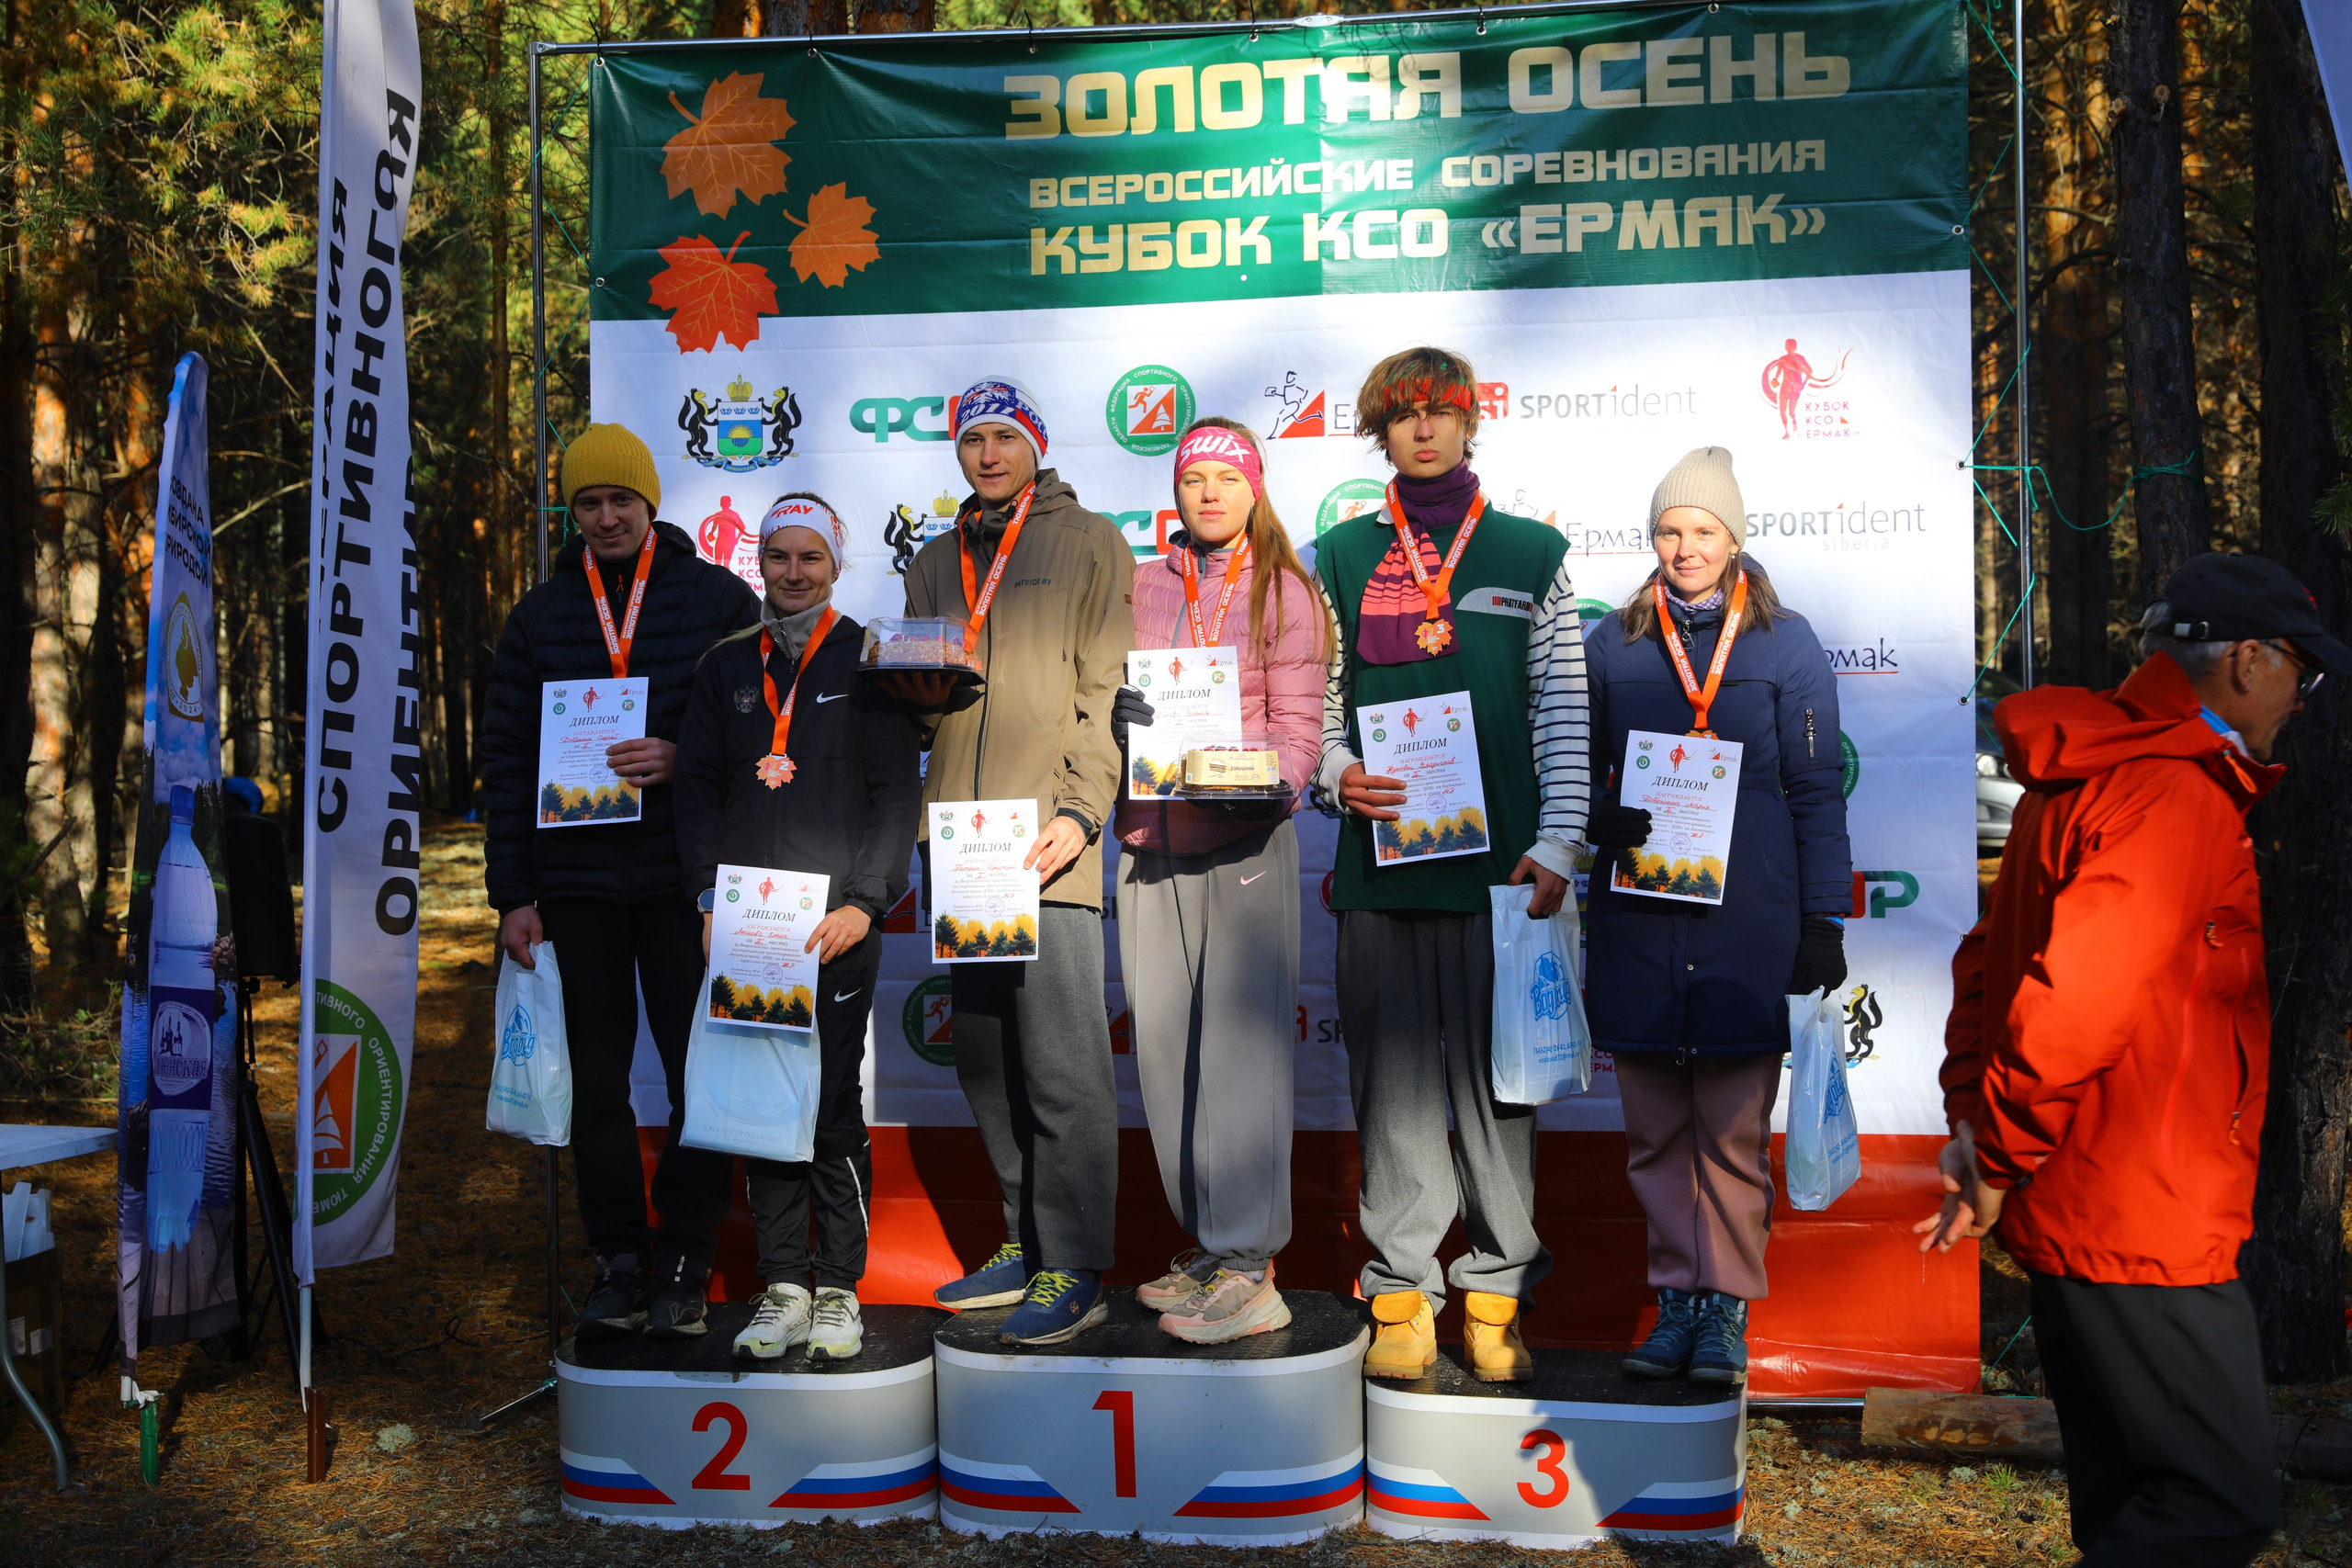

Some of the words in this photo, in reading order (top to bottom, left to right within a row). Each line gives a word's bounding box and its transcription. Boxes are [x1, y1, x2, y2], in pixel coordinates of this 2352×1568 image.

[1004, 51, 1462, 140] ЗОЛОТАЯ
[1508, 31, 1850, 113] ОСЕНЬ
[1030, 157, 1413, 209] ВСЕРОССИЙСКИЕ
[1441, 140, 1826, 187] СОРЕВНОВАНИЯ
[1030, 215, 1272, 275] КУБОК
[1302, 209, 1448, 261] КСО
[1481, 194, 1826, 254] «ЕРМАК»
[1133, 368, 1178, 382] СПОРТИВНОГО
[1110, 378, 1131, 413] ФЕДЕРАЦИЯ
[1805, 400, 1850, 412] КУБОК
[1110, 416, 1128, 443] ОБЛАСТИ
[1805, 416, 1834, 425] КСО
[1131, 442, 1171, 453] ТЮМЕНСКОЙ
[317, 147, 397, 833] СПОРТИВНОГО
[1012, 494, 1030, 525] ТЮМЕНЬ
[1320, 491, 1342, 527] ФЕДЕРАЦИЯ
[1403, 525, 1416, 548] ОСЕНЬ
[1448, 536, 1466, 570] ЗОЛОТАЯ
[1463, 517, 1477, 538] ОСЕНЬ
[1823, 537, 1890, 551] siberia
[1410, 548, 1429, 581] ЗОЛОТАЯ
[978, 581, 997, 616] ЗОЛОТАЯ
[993, 554, 1008, 580] ОСЕНЬ
[1014, 579, 1040, 589] PATRIOT
[600, 595, 610, 620] ОСЕНЬ
[626, 605, 639, 639] ЗОЛОТАЯ
[634, 579, 646, 604] ОСЕНЬ
[1193, 600, 1202, 623] ОСЕНЬ
[1212, 608, 1227, 642] ЗОЛОТАЯ
[1222, 582, 1235, 606] ОСЕНЬ
[606, 621, 620, 654] ЗОЛОТАЯ
[1436, 623, 1445, 634] 3
[1671, 631, 1683, 657] ОСЕНЬ
[1714, 637, 1732, 675] ЗОЛОТАЯ
[1726, 612, 1740, 638] ОСЕНЬ
[1679, 657, 1698, 693] ЗОЛОТАЯ
[1157, 689, 1211, 702] ДИПЛОМ
[179, 703, 198, 714] 2024
[569, 715, 620, 728] ДИПЛОМ
[1394, 738, 1447, 755] ДИПЛОМ
[1721, 754, 1737, 762] Ермак
[779, 761, 789, 772] 2
[1399, 753, 1446, 764] НАГРАЖДАЕТСЯ
[1651, 775, 1709, 792] ДИПЛОМ
[1656, 791, 1702, 801] НАГРАЖДАЕТСЯ
[959, 842, 1012, 854] ДИПЛОМ
[741, 908, 797, 922] ДИПЛОМ
[746, 923, 791, 933] НАГРАЖДАЕТСЯ
[353, 1037, 393, 1184] ОРИЕНТИРОВАНИЯ
[703, 1124, 734, 1135] КАТАЛОГ
[736, 1129, 781, 1143] ПРОДУКЦИИ
[715, 1134, 729, 1142] ООО
[692, 1401, 751, 1490] 2
[1091, 1390, 1136, 1498] 1
[1516, 1427, 1570, 1508] 3
